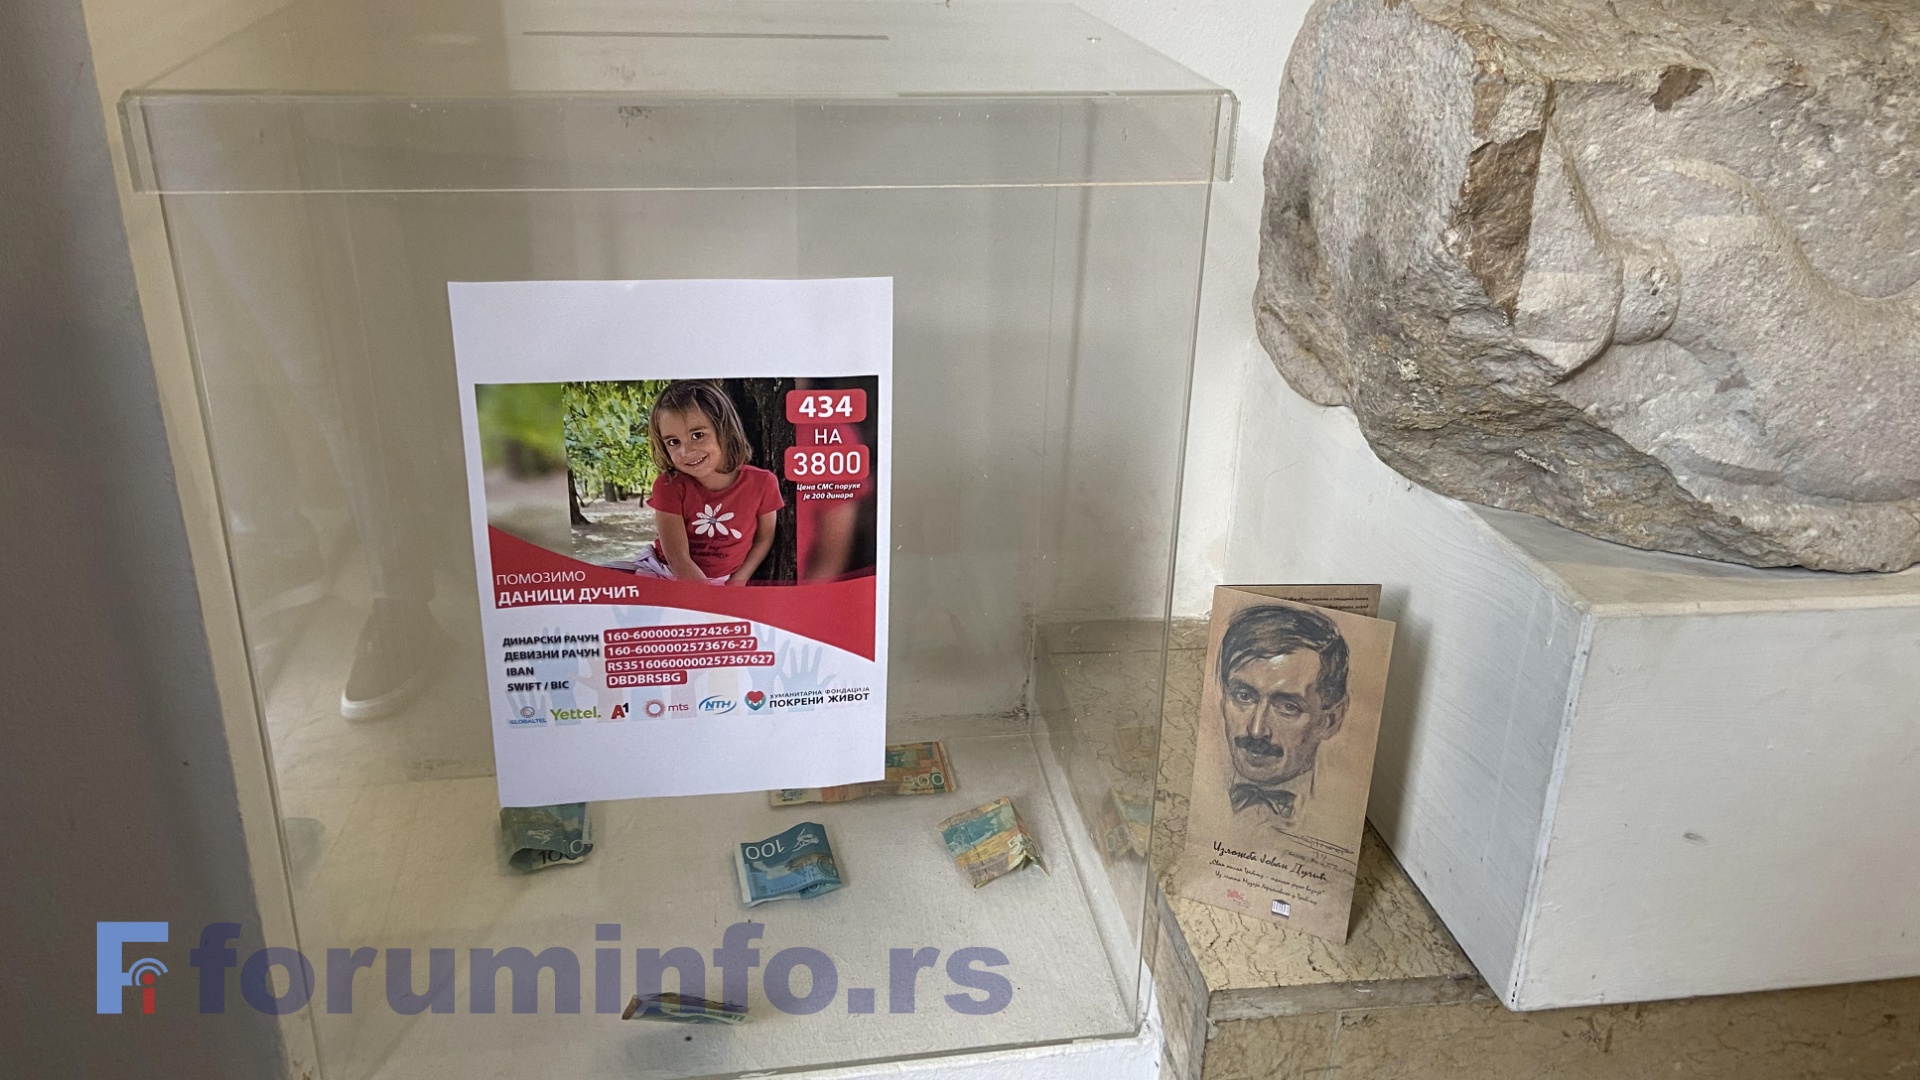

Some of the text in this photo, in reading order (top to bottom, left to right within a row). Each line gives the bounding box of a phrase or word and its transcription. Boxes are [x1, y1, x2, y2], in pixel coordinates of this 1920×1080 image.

[798, 395, 853, 418] 434
[814, 428, 843, 445] НА
[792, 451, 861, 476] 3800
[796, 482, 861, 492] Цена СМС поруке
[803, 492, 811, 501] је
[825, 491, 854, 500] динара
[496, 570, 586, 586] ПОМОЗИМО
[498, 585, 640, 607] ДАНИЦИ ДУЧИЋ
[502, 633, 600, 648] ДИНАРСКИ РАЧУН
[606, 625, 749, 642] 160-6000002572426-91
[503, 648, 600, 663] ДЕВИЗНИ РАЧУН
[607, 639, 756, 657] 160-6000002573676-27
[607, 654, 774, 672] RS35160600000257367627
[506, 667, 535, 677] IBAN
[608, 671, 682, 687] DBDBRSBG
[507, 681, 542, 692] SWIFT
[550, 680, 570, 690] BIC
[769, 686, 870, 700] ХУМАНИТАРНА ФОНДАЦИЈА
[668, 702, 690, 712] mts
[704, 699, 732, 710] NTH
[769, 692, 870, 708] ПОКРЕНИ ЖИВОТ
[509, 717, 547, 725] GLOBALTEL
[550, 706, 602, 721] Yettel.
[902, 773, 945, 787] 500
[745, 839, 786, 860] 100
[1213, 840, 1258, 863] Изложба
[1260, 853, 1288, 870] Јован
[1289, 863, 1328, 882] Дучић
